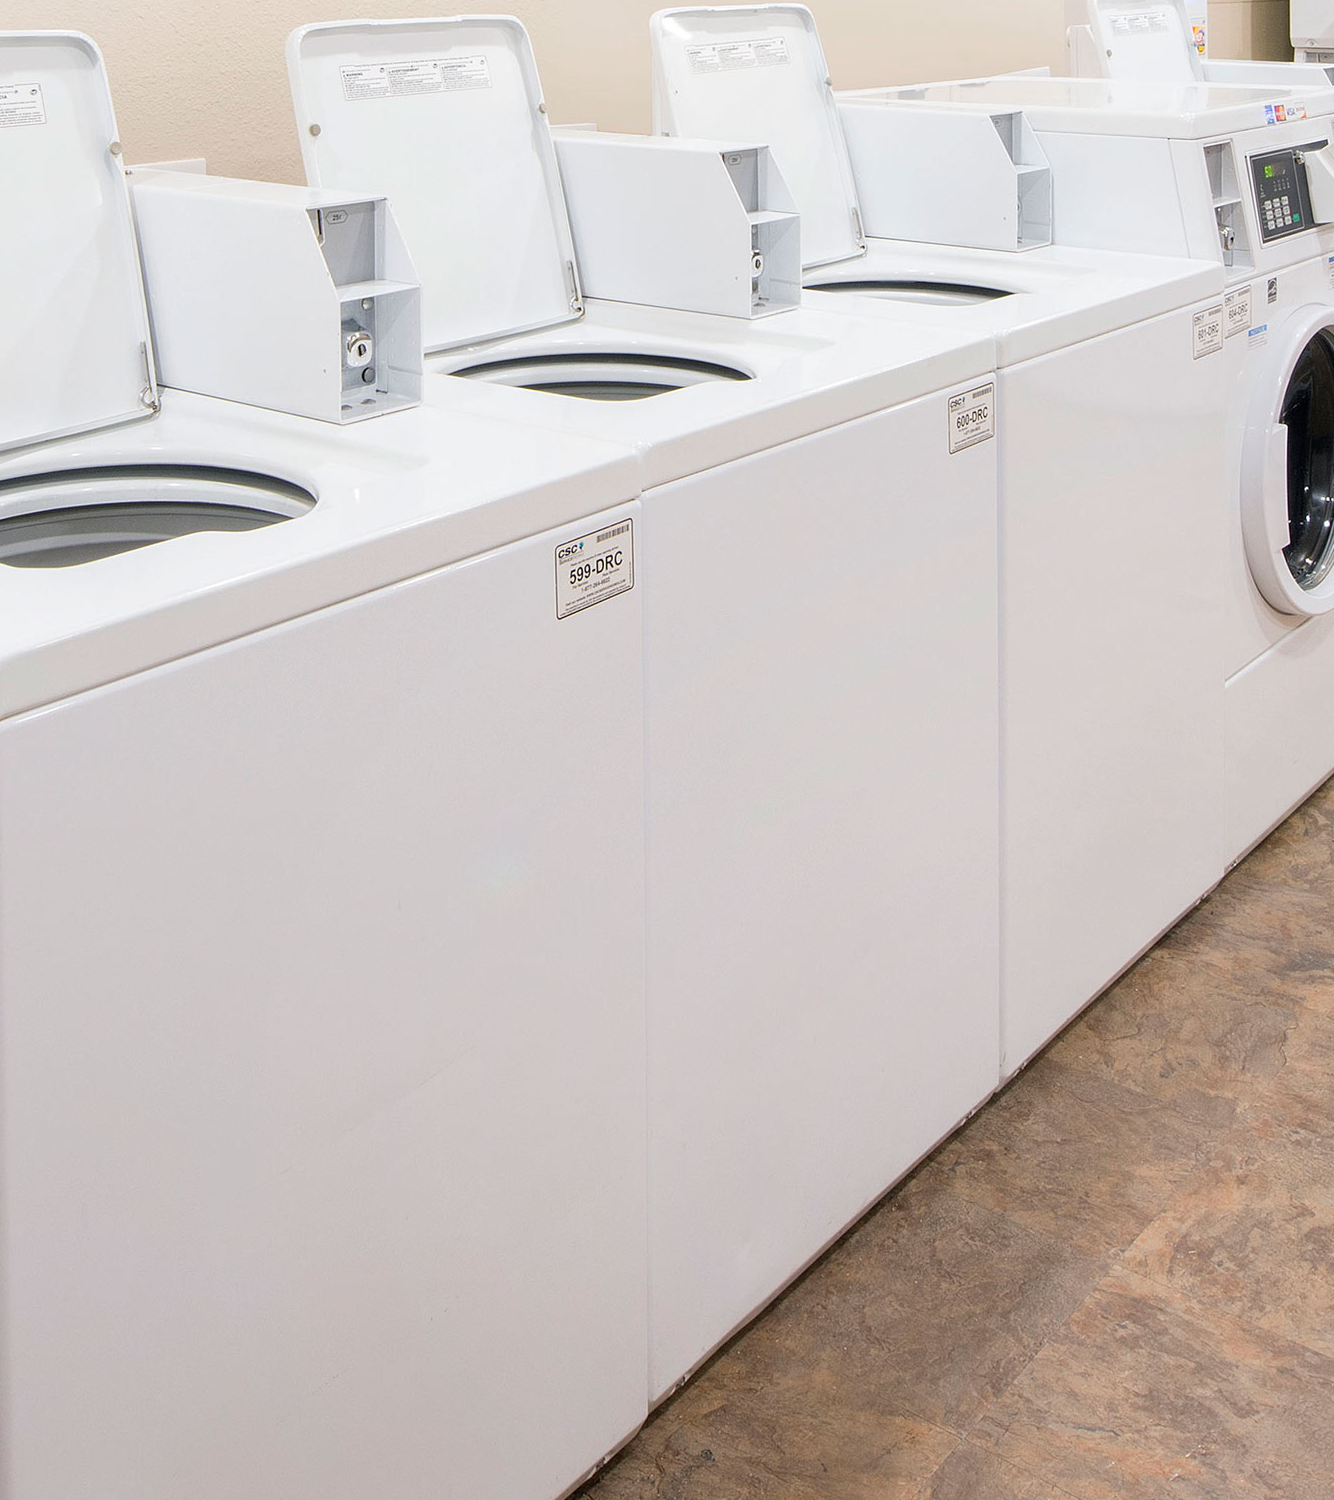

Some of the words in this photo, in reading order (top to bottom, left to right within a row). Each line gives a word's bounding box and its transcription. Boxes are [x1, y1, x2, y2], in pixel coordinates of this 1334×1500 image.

[956, 406, 988, 429] 600-DRC
[558, 544, 578, 559] CSC
[569, 550, 623, 585] 599-DRC
